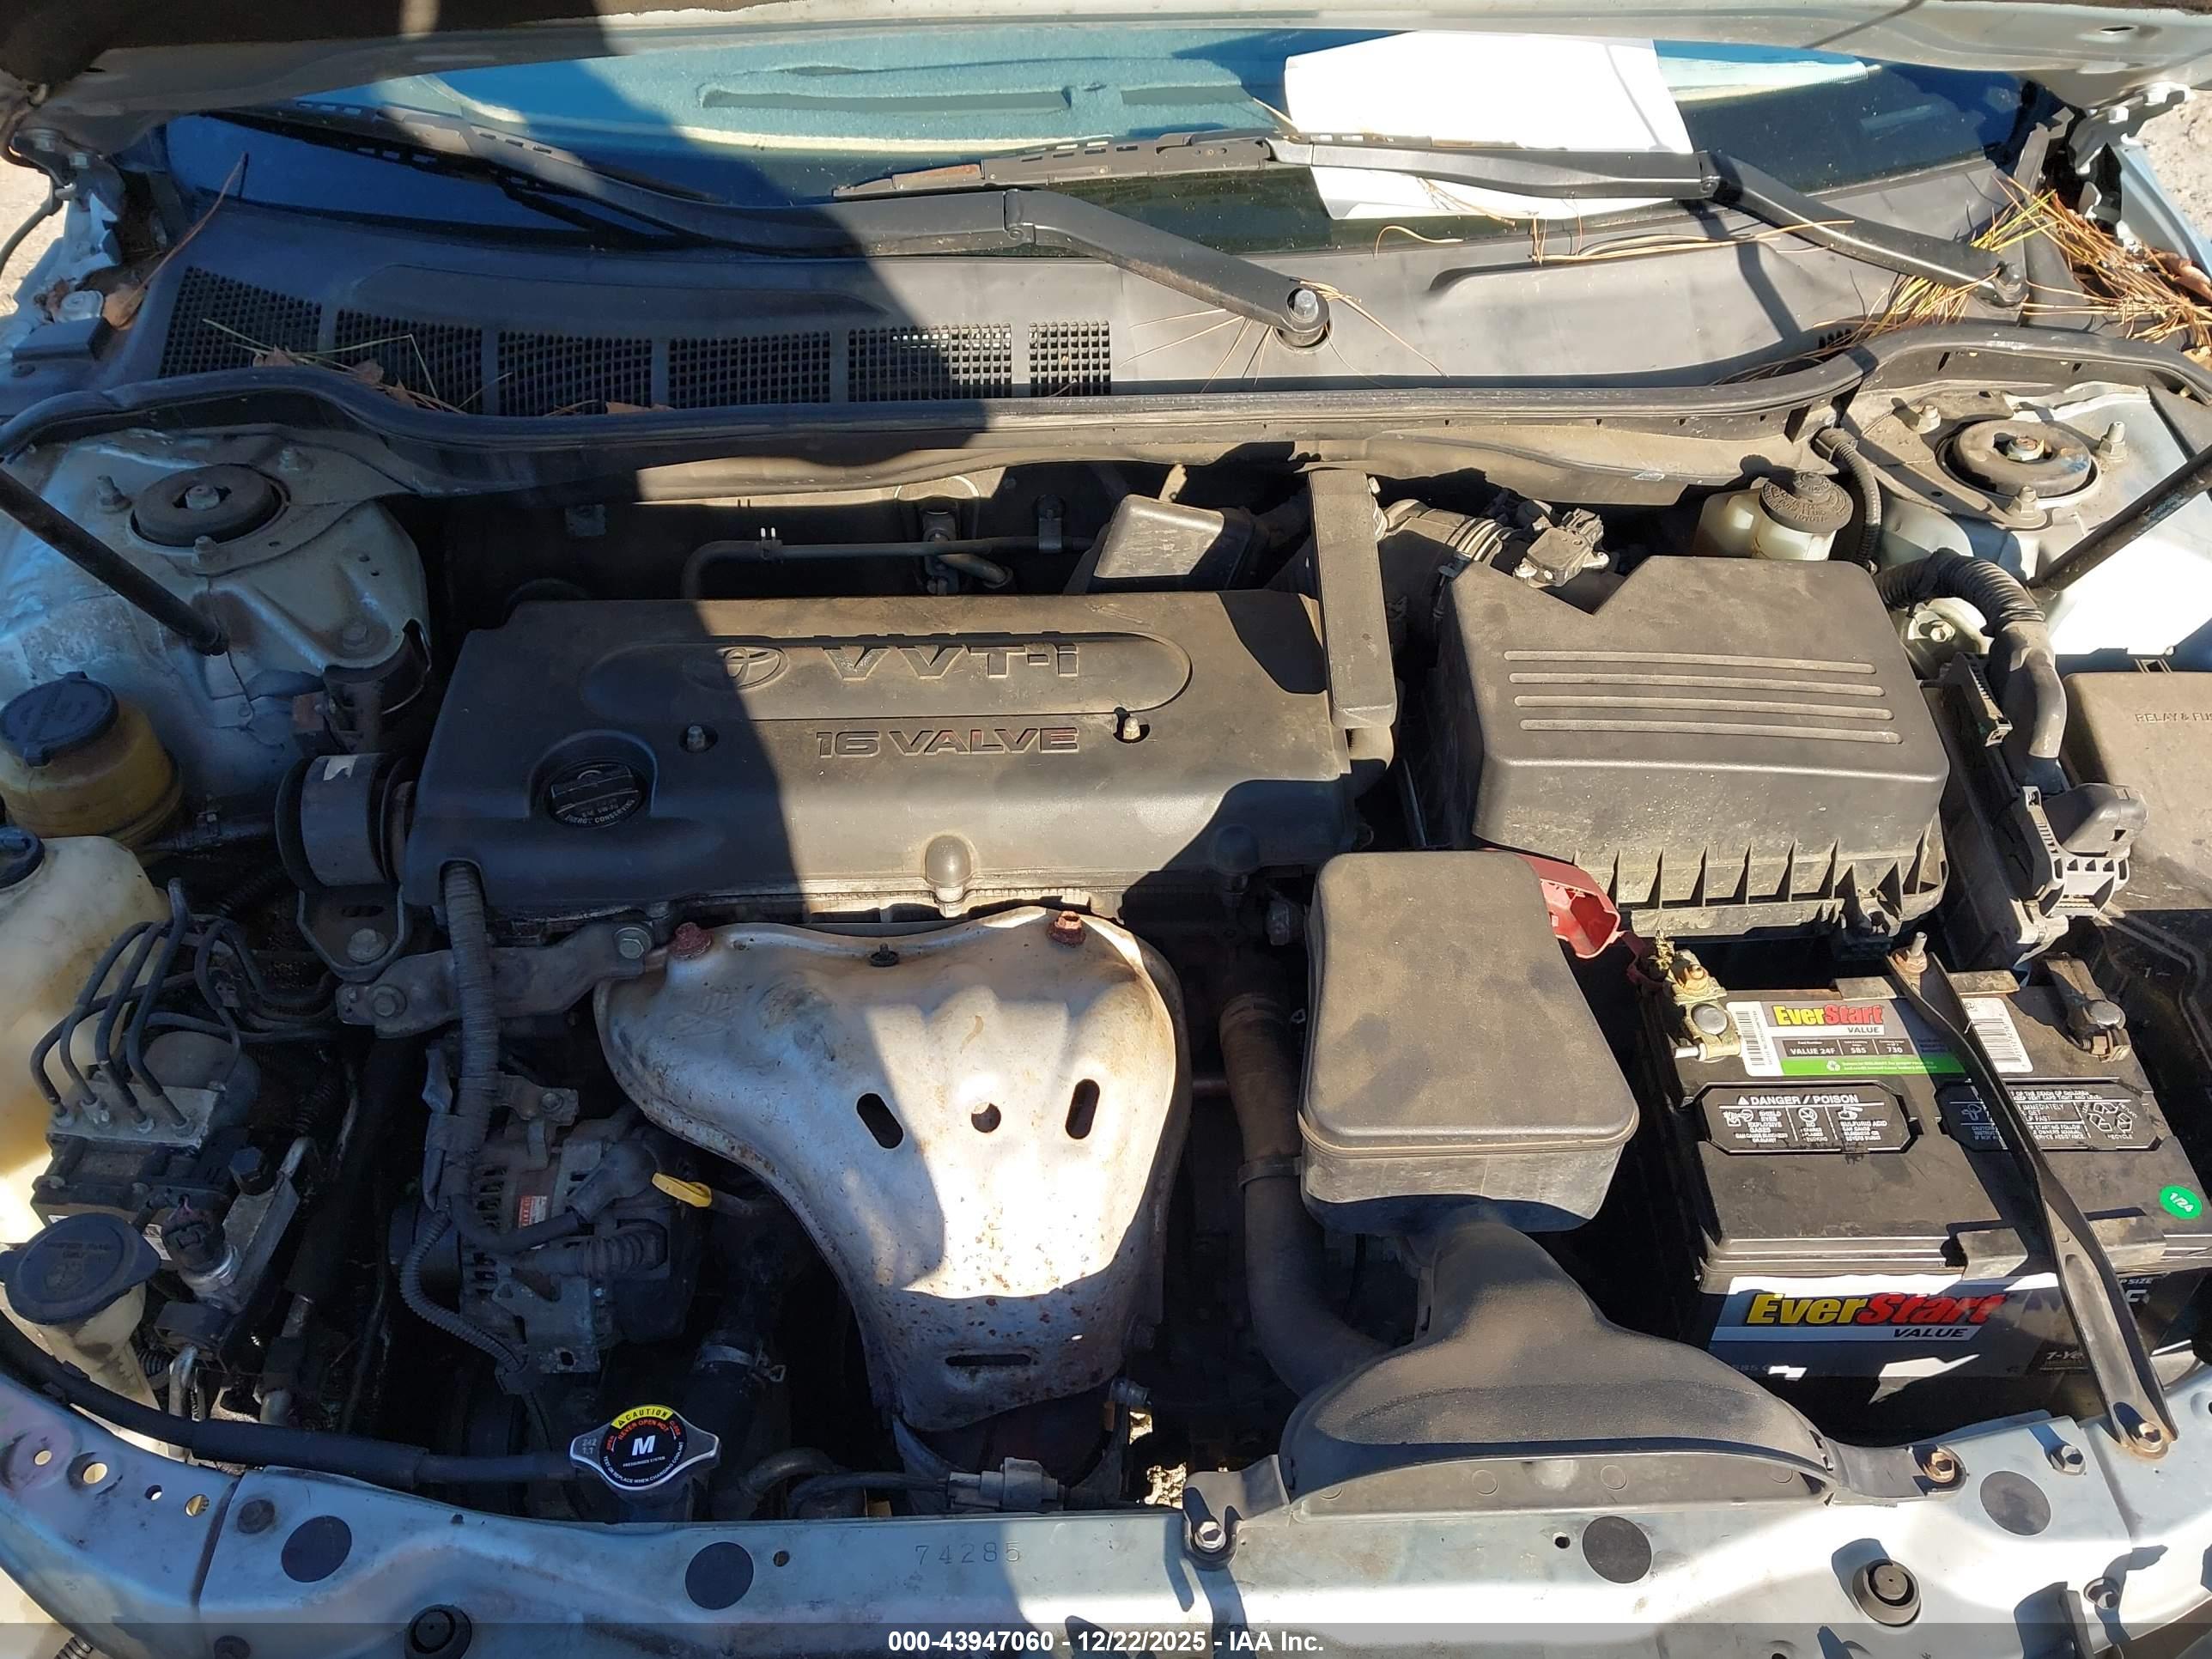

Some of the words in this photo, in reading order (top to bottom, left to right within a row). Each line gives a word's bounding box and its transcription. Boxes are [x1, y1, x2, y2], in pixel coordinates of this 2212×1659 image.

[822, 644, 1079, 680] VVT-i
[2135, 713, 2178, 721] RELAY
[817, 731, 880, 757] 16
[888, 727, 1079, 756] VALVE
[1772, 1004, 1884, 1026] EverStart
[1750, 1096, 1801, 1105] DANGER
[1812, 1094, 1859, 1104] POISON
[2168, 1192, 2194, 1213] 1/24
[1746, 1292, 2008, 1325] EverStart
[1892, 1328, 1968, 1339] VALUE
[625, 1408, 669, 1421] CAUTION
[631, 1435, 656, 1456] M
[612, 1470, 634, 1483] REPLACE
[649, 1462, 674, 1482] CHANGING
[672, 1441, 684, 1464] COOLANT
[915, 1540, 1021, 1565] 74285
